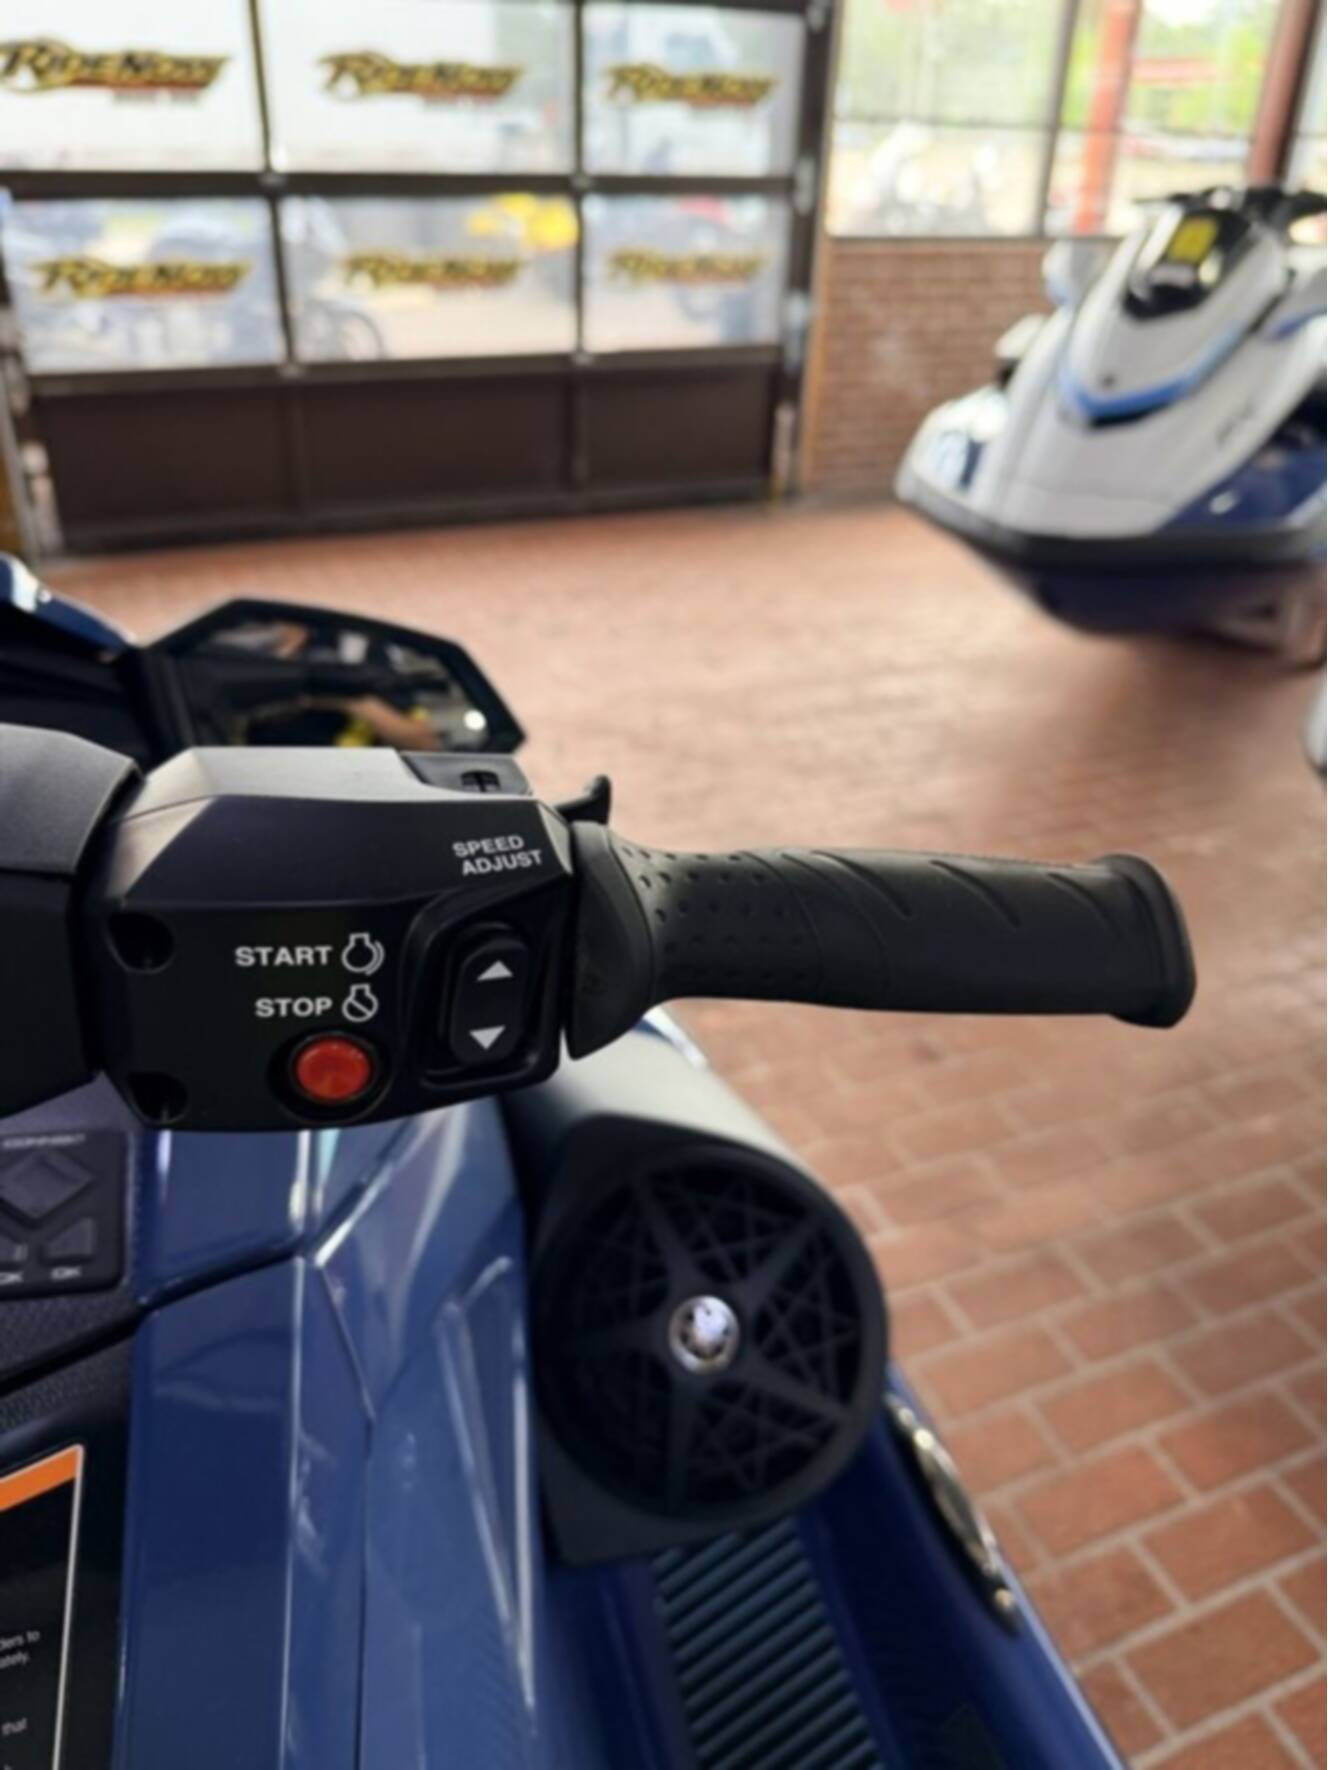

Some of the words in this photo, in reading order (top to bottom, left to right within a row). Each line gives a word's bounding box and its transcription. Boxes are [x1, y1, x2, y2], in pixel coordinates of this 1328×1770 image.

[451, 834, 525, 858] SPEED
[461, 849, 544, 876] ADJUST
[234, 945, 333, 968] START
[254, 997, 333, 1018] STOP
